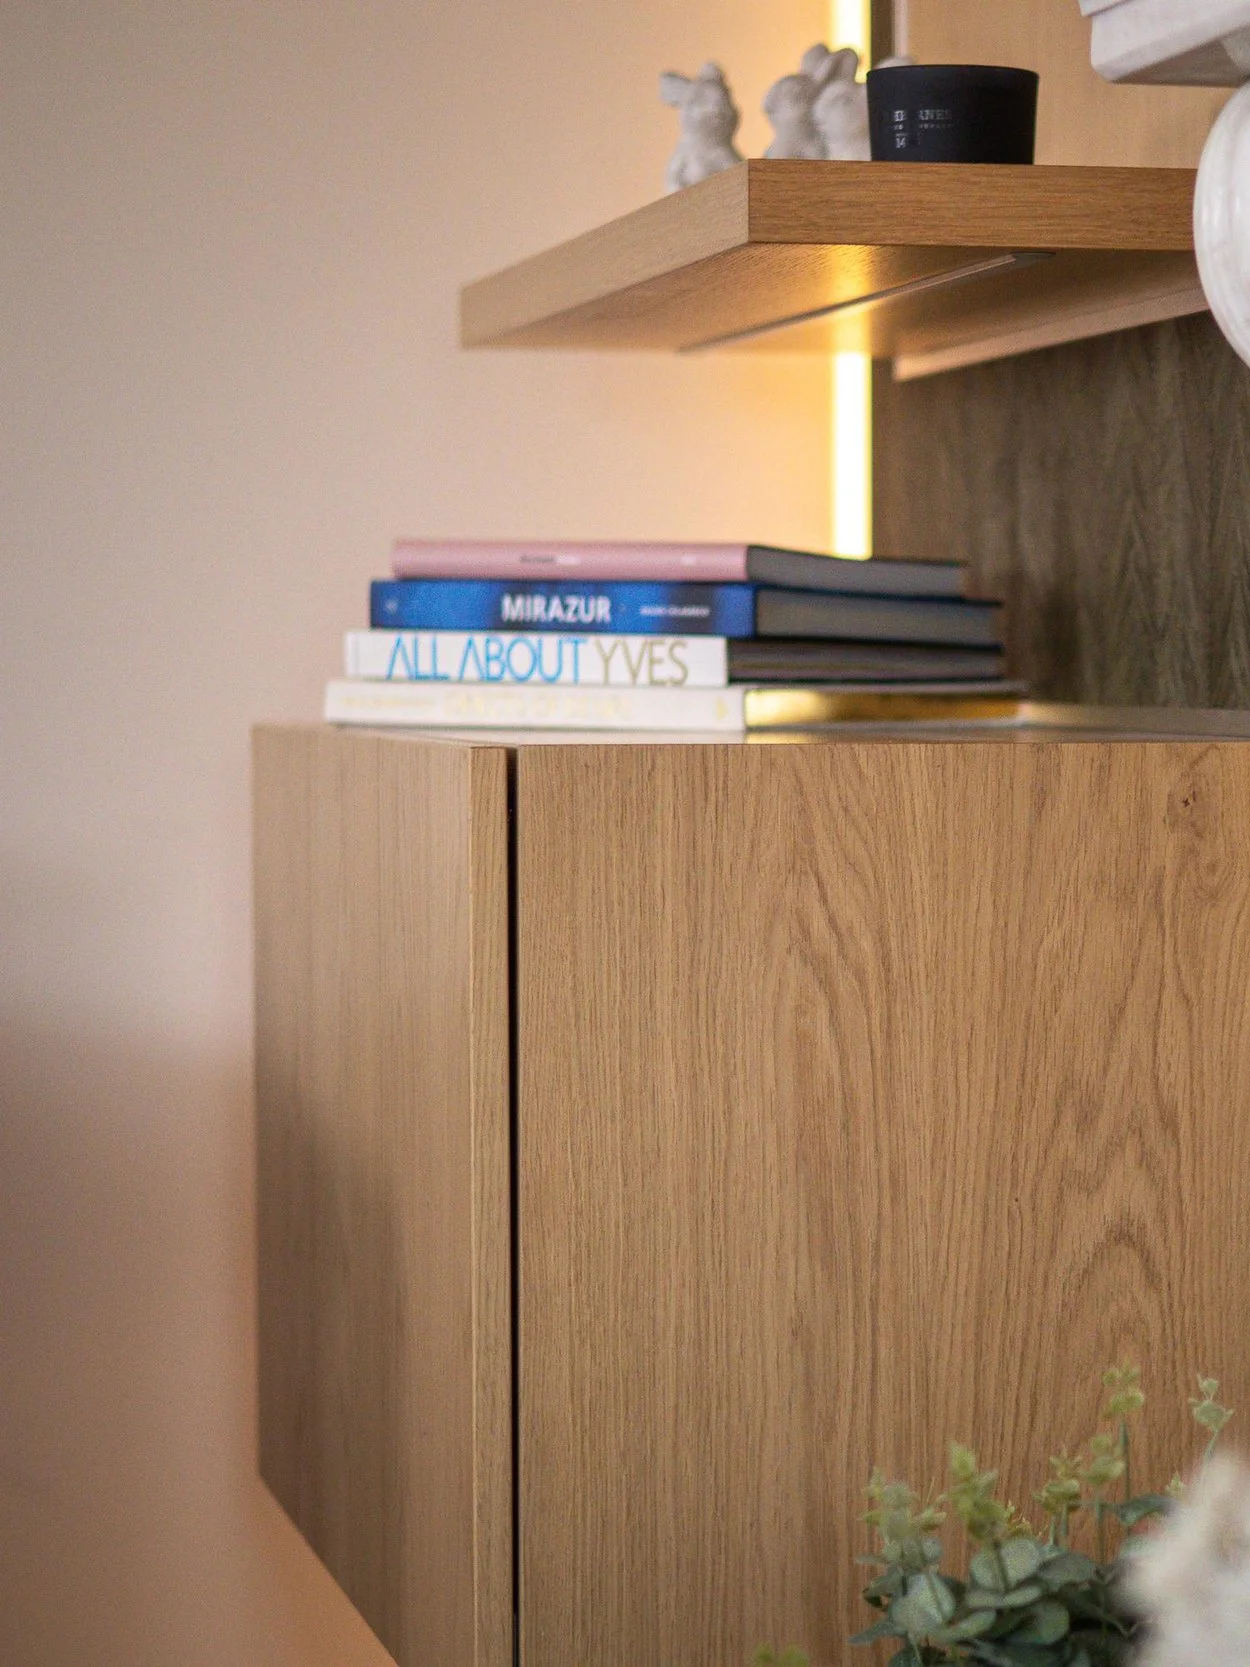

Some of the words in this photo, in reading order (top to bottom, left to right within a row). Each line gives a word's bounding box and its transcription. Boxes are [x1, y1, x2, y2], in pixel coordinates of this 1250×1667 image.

[502, 594, 611, 623] MIRAZUR
[386, 633, 449, 681] ALL
[459, 635, 587, 684] ABOUT
[595, 638, 689, 687] YVES
